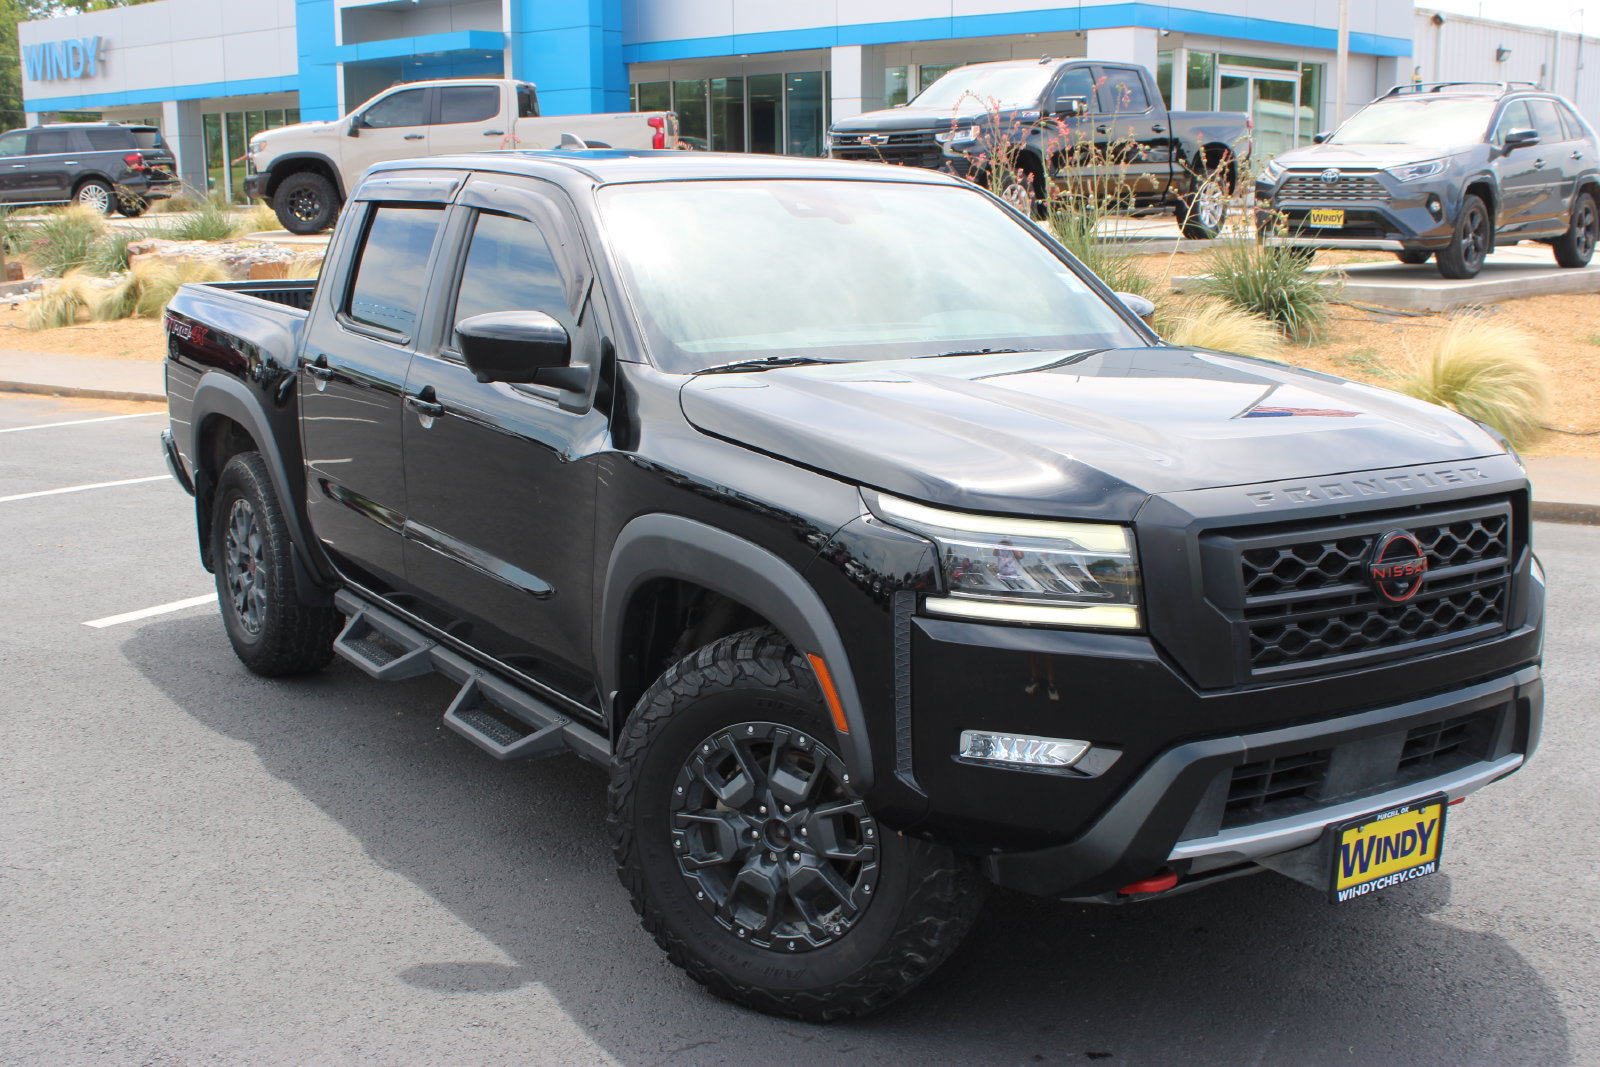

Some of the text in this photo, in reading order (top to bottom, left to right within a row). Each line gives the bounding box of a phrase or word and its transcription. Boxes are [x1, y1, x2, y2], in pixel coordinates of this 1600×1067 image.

[22, 35, 101, 82] WINDY
[1312, 213, 1343, 223] WINDY
[1246, 467, 1489, 507] FRONTIER
[1341, 818, 1438, 878] WINDY
[1338, 862, 1436, 902] WINDYCHEV.COM
